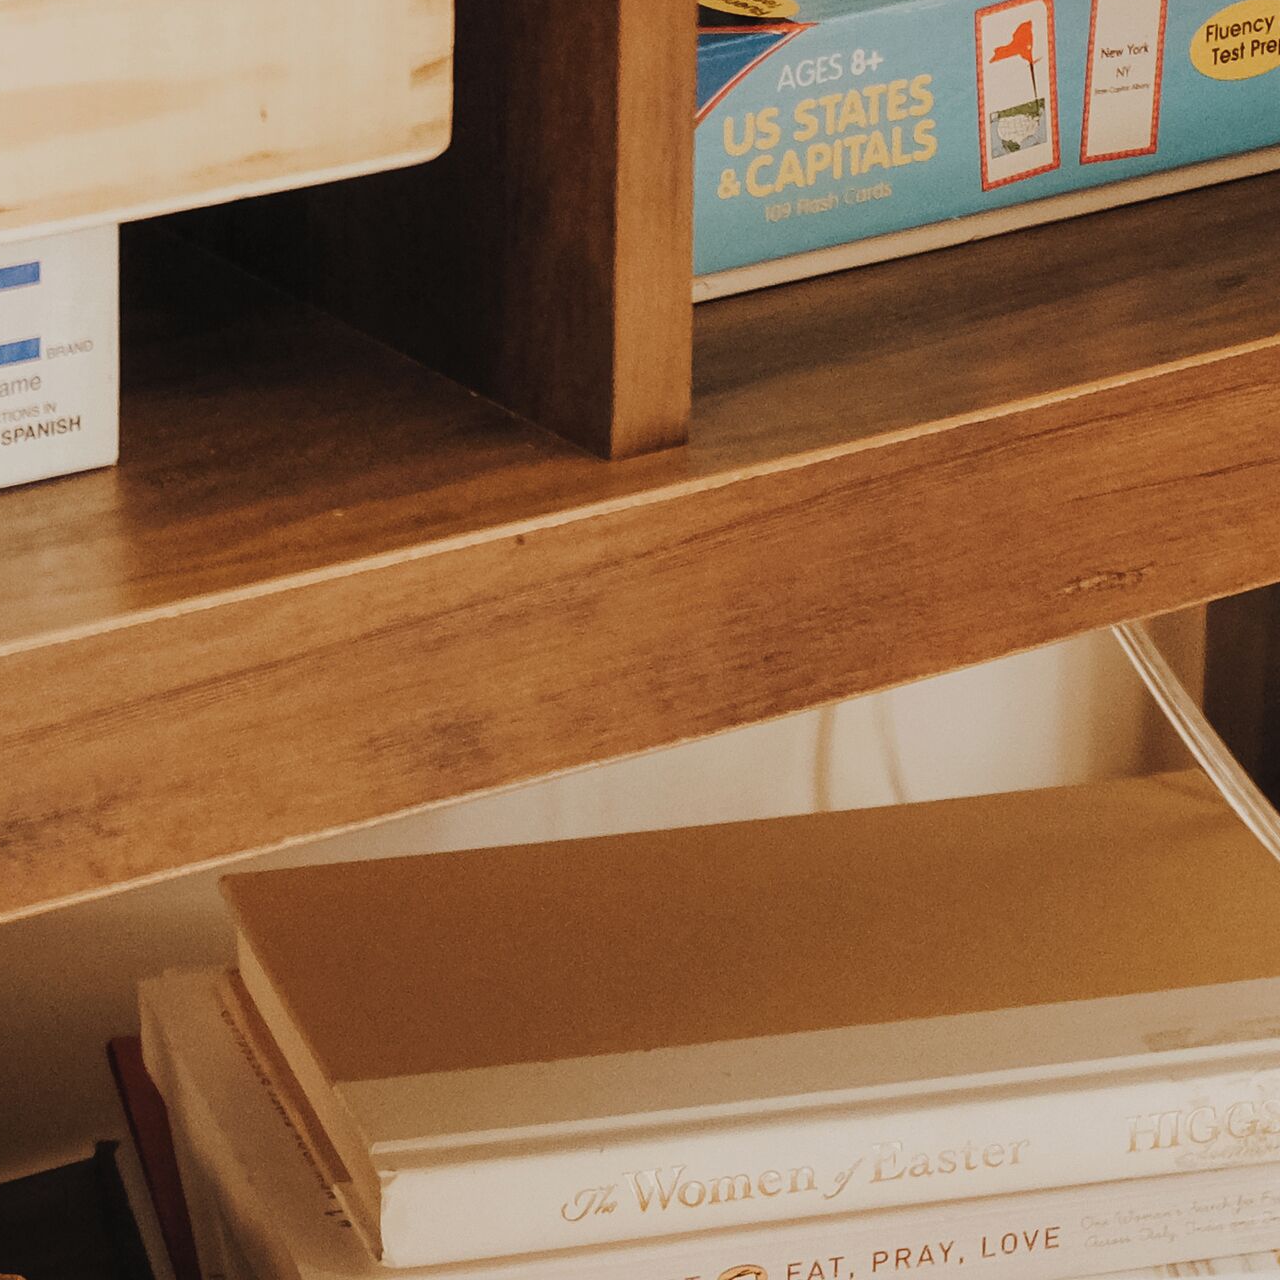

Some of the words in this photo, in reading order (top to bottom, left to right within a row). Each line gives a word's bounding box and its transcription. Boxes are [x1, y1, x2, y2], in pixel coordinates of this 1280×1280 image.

[1205, 14, 1276, 44] Fluency
[1099, 46, 1124, 60] New
[1126, 43, 1150, 55] York
[1210, 42, 1246, 66] Test
[775, 53, 845, 92] AGES
[850, 48, 886, 78] 8+
[1115, 65, 1132, 78] NY
[722, 106, 782, 158] US
[792, 72, 936, 143] STATES
[744, 118, 939, 199] CAPITALS
[45, 338, 95, 361] BRAND
[42, 400, 58, 415] IN
[0, 415, 83, 449] SPANISH
[559, 1182, 620, 1223] The
[621, 1163, 818, 1215] Women
[821, 1155, 865, 1202] of
[868, 1136, 1032, 1186] Easter
[786, 1255, 855, 1280] EAT,
[871, 1239, 966, 1274] PRAY,
[981, 1225, 1062, 1259] LOVE
